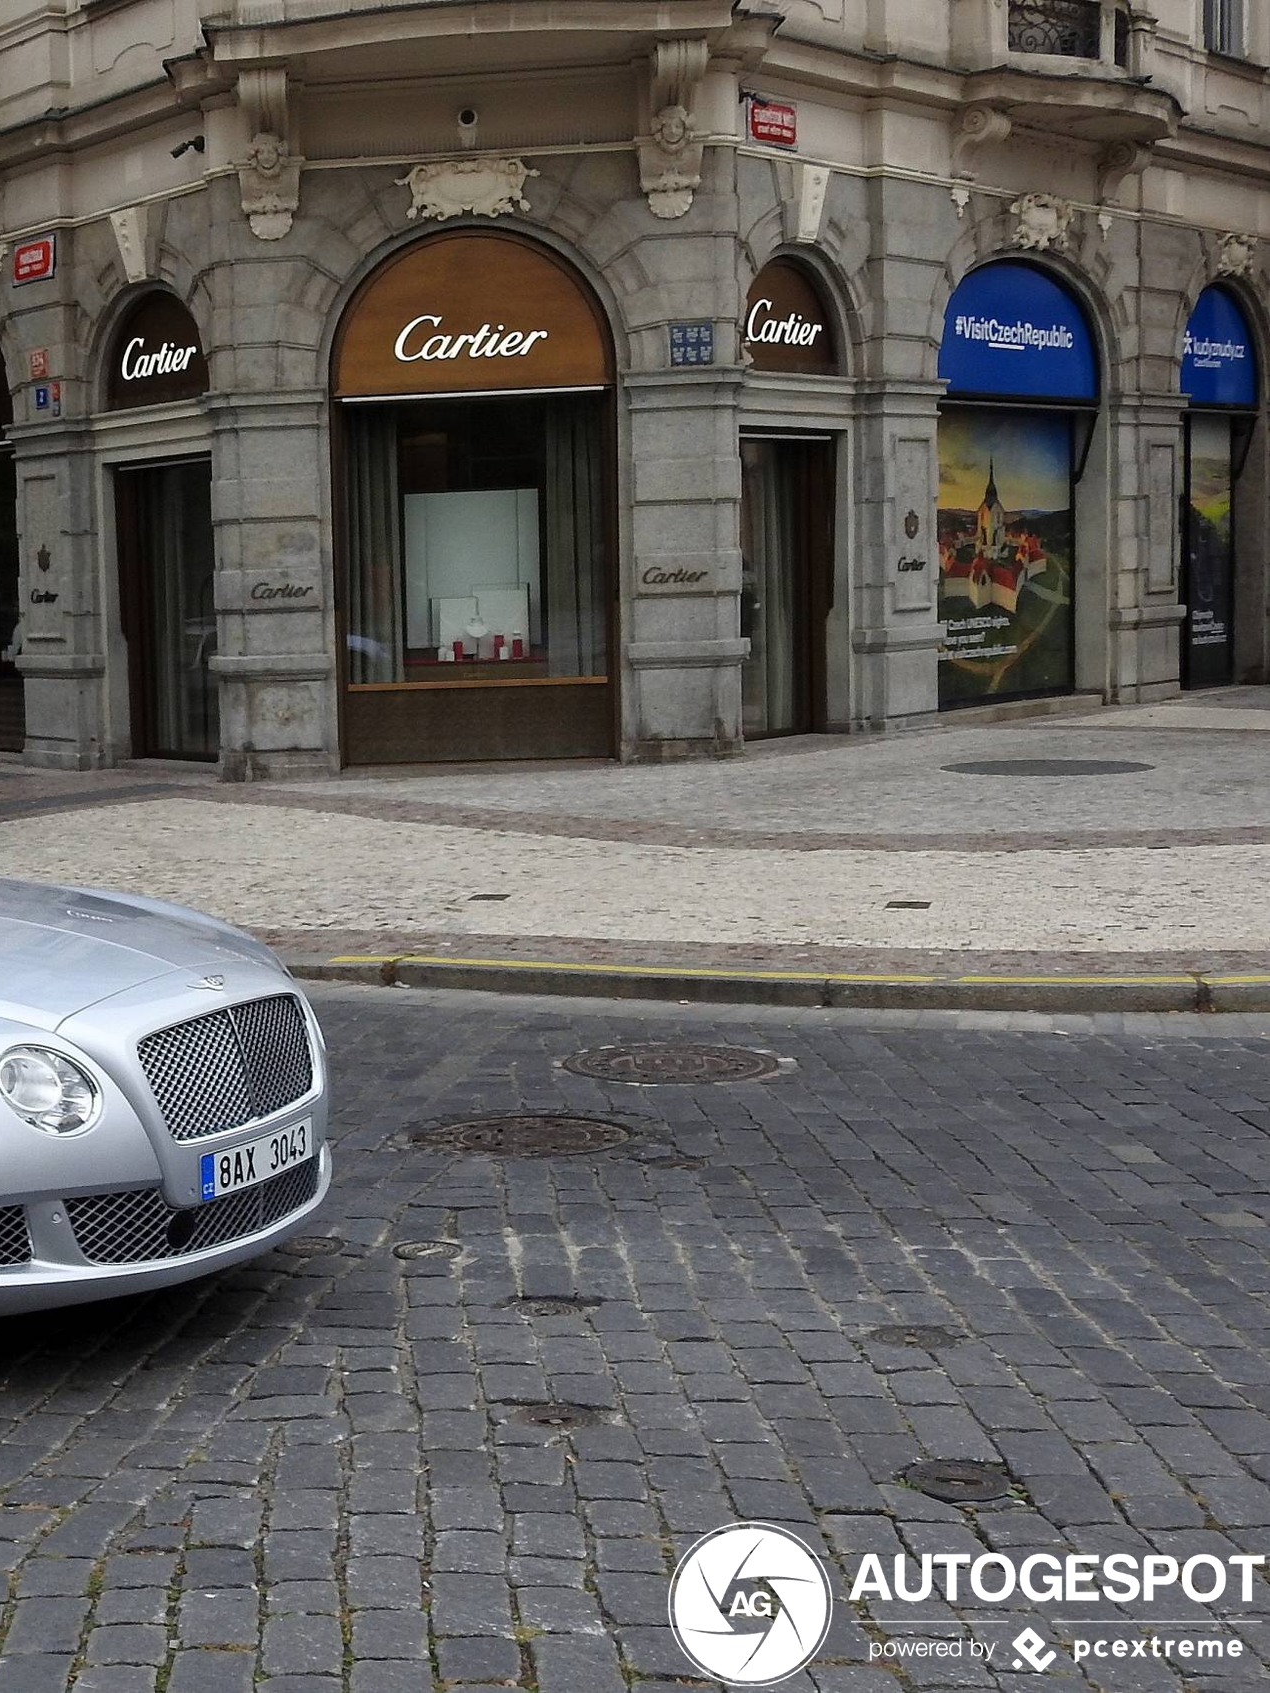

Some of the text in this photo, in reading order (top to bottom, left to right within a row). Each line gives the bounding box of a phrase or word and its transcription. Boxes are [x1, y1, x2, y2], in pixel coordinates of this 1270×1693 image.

[395, 315, 548, 361] Cartier
[746, 299, 822, 345] Cartier
[956, 316, 1073, 350] #VisitCzechRepublic
[122, 337, 197, 380] Cartier
[250, 582, 313, 600] Cartier
[641, 566, 709, 585] Cartier
[219, 1125, 306, 1189] 8AX 3043
